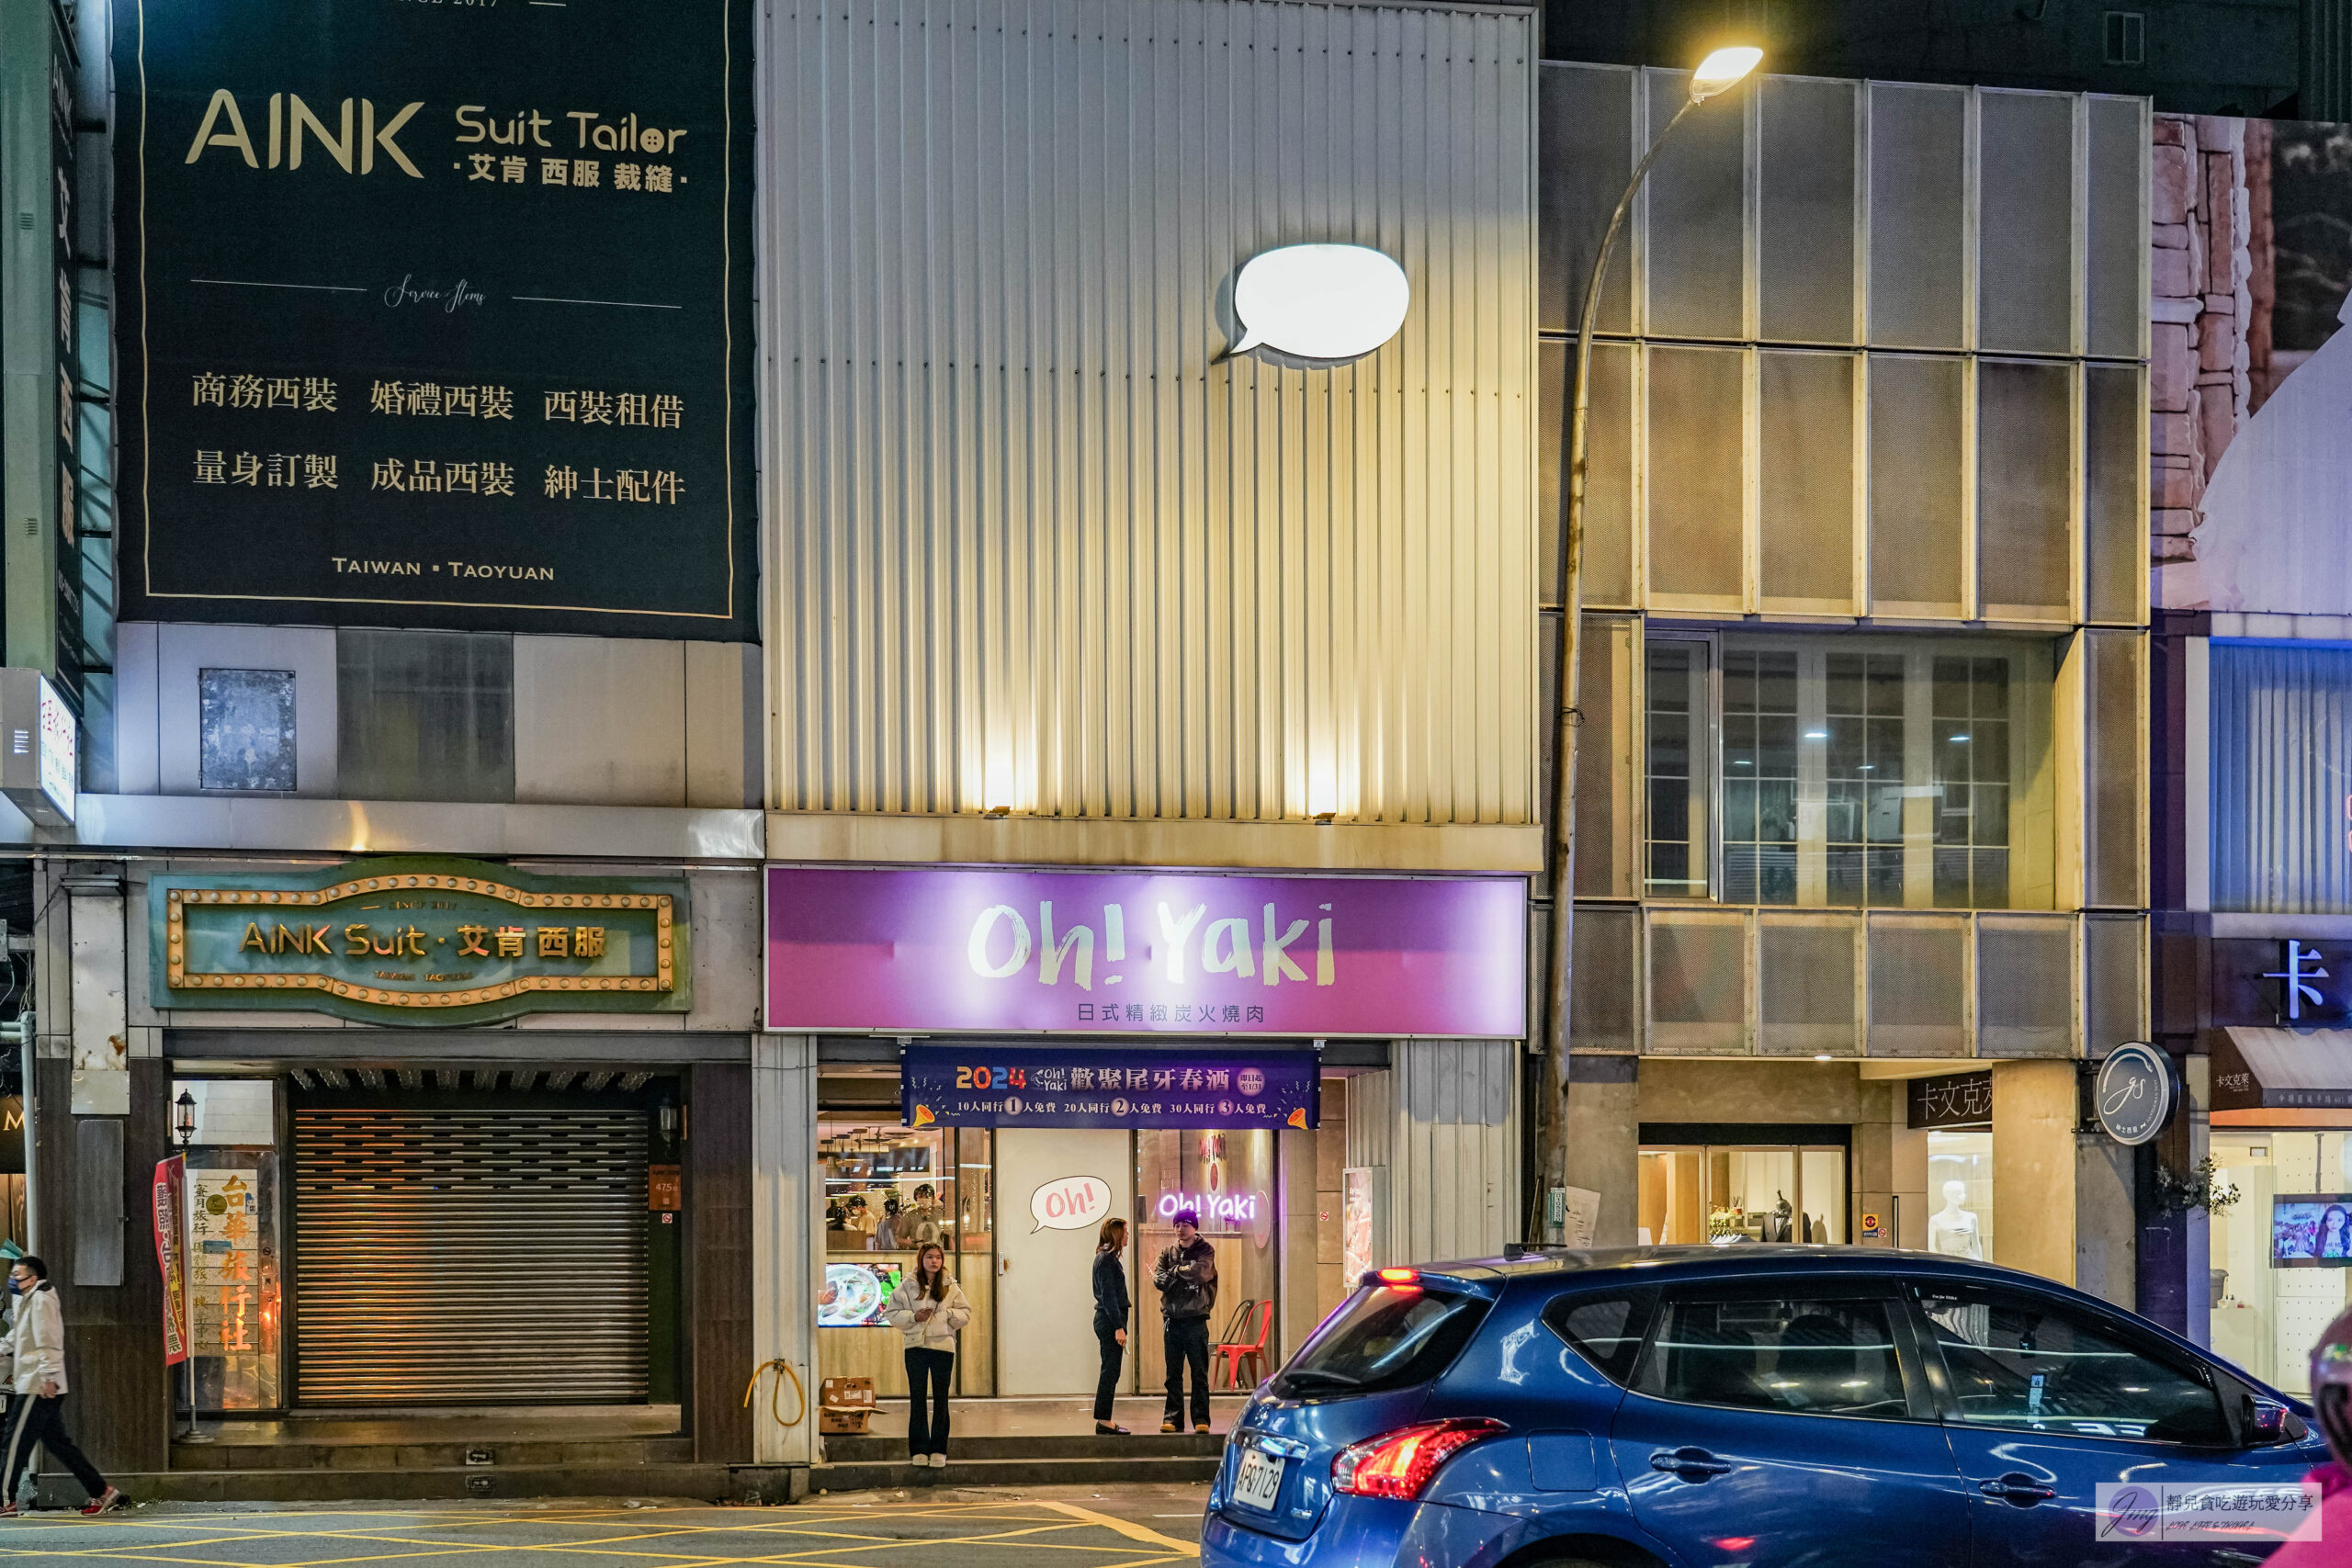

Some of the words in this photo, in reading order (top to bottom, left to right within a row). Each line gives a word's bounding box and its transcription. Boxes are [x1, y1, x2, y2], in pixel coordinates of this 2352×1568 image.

[185, 88, 425, 178] AINK
[456, 105, 552, 148] Suit
[566, 111, 688, 154] Tailor
[192, 371, 338, 412] 商務西裝
[370, 379, 514, 421] 婚禮西裝
[544, 390, 684, 429] 西裝租借
[192, 449, 339, 490] 量身訂製
[371, 457, 515, 497] 成品西裝
[544, 464, 686, 505] 紳士配件
[332, 557, 421, 576] TAIWAN
[448, 561, 554, 581] TAOYUAN
[239, 921, 333, 954] AINK
[345, 923, 425, 956] Suit
[967, 900, 1125, 991] Oh!
[1157, 901, 1335, 987] Yaki
[2262, 940, 2330, 1020] 卡
[1078, 1003, 1265, 1023] 日式精緻炭火燒肉
[956, 1066, 1026, 1089] 2024
[1044, 1067, 1065, 1079] Oh!
[1044, 1078, 1068, 1091] Yaki
[1070, 1067, 1230, 1091] 歡聚尾牙春酒
[2216, 1073, 2249, 1087] 卡文克萊
[194, 1183, 209, 1236] 蜜月旅行
[1046, 1182, 1095, 1218] Oh!
[1207, 1194, 1257, 1220] Yaki
[220, 1174, 254, 1352] 台華旅行社
